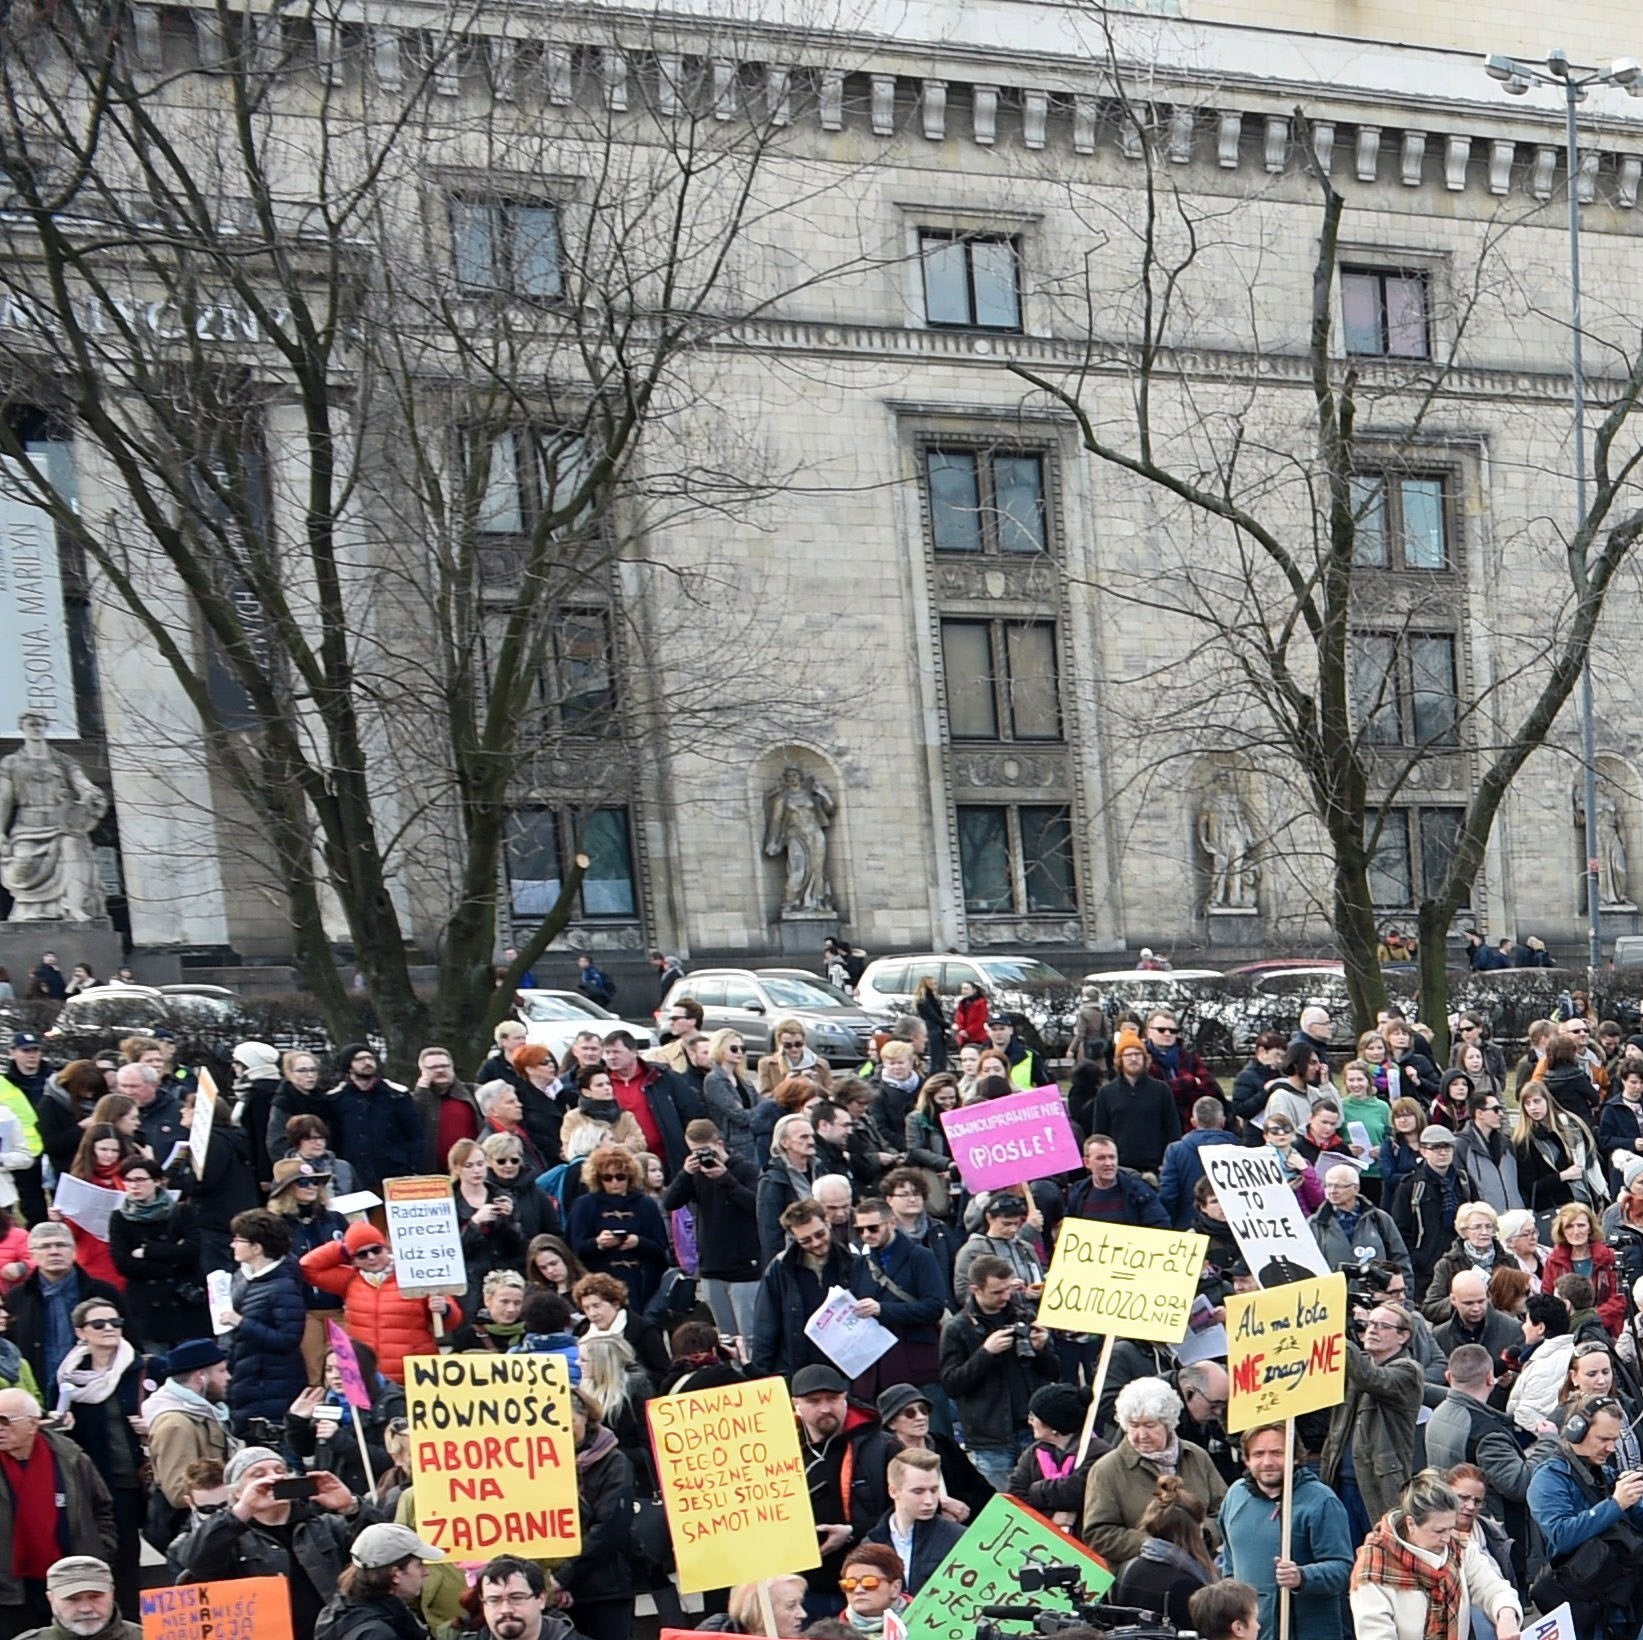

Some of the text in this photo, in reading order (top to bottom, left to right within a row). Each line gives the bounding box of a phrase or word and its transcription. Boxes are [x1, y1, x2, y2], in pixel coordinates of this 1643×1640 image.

[8, 522, 48, 617] MARILYN
[1210, 1156, 1283, 1191] CZARNO
[390, 1202, 451, 1220] Radziwiłł
[1237, 1189, 1265, 1211] TO
[396, 1220, 450, 1237] precz!
[431, 1244, 456, 1260] się
[410, 1264, 450, 1279] lecz!
[1235, 1300, 1265, 1342] Ala
[1295, 1288, 1328, 1329] kota
[413, 1355, 567, 1396] WOLNOŚĆ,
[1233, 1352, 1265, 1398] NIE
[1309, 1332, 1343, 1377] NIE
[658, 1386, 775, 1428] STAWAJ W
[664, 1411, 769, 1456] OBRONIE
[418, 1435, 562, 1480] ABORCJA
[668, 1441, 770, 1475] TEGO CO
[449, 1476, 504, 1503] NA
[677, 1479, 797, 1514] JEŚLI STOISZ
[421, 1506, 578, 1555] ŻĄDANIE
